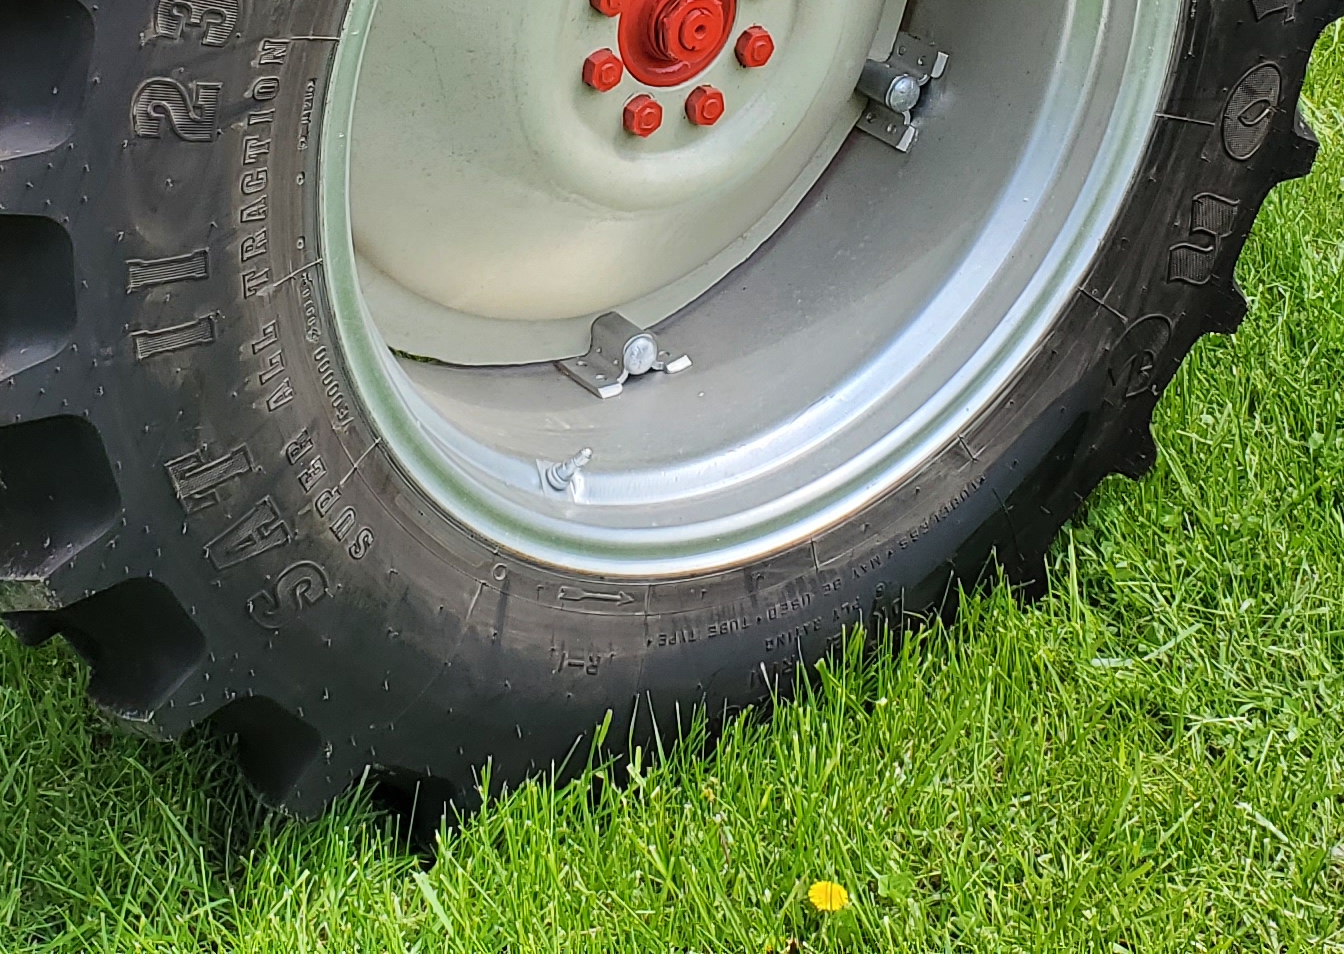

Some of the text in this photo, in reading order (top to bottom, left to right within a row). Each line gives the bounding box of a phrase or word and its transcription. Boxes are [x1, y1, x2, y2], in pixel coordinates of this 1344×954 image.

[238, 37, 293, 300] TRACTION
[250, 320, 298, 414] ALL
[163, 440, 332, 630] SAT
[284, 427, 376, 561] SUPER
[657, 629, 698, 647] TYPE
[706, 617, 751, 638] TUBE
[767, 593, 813, 622] USED
